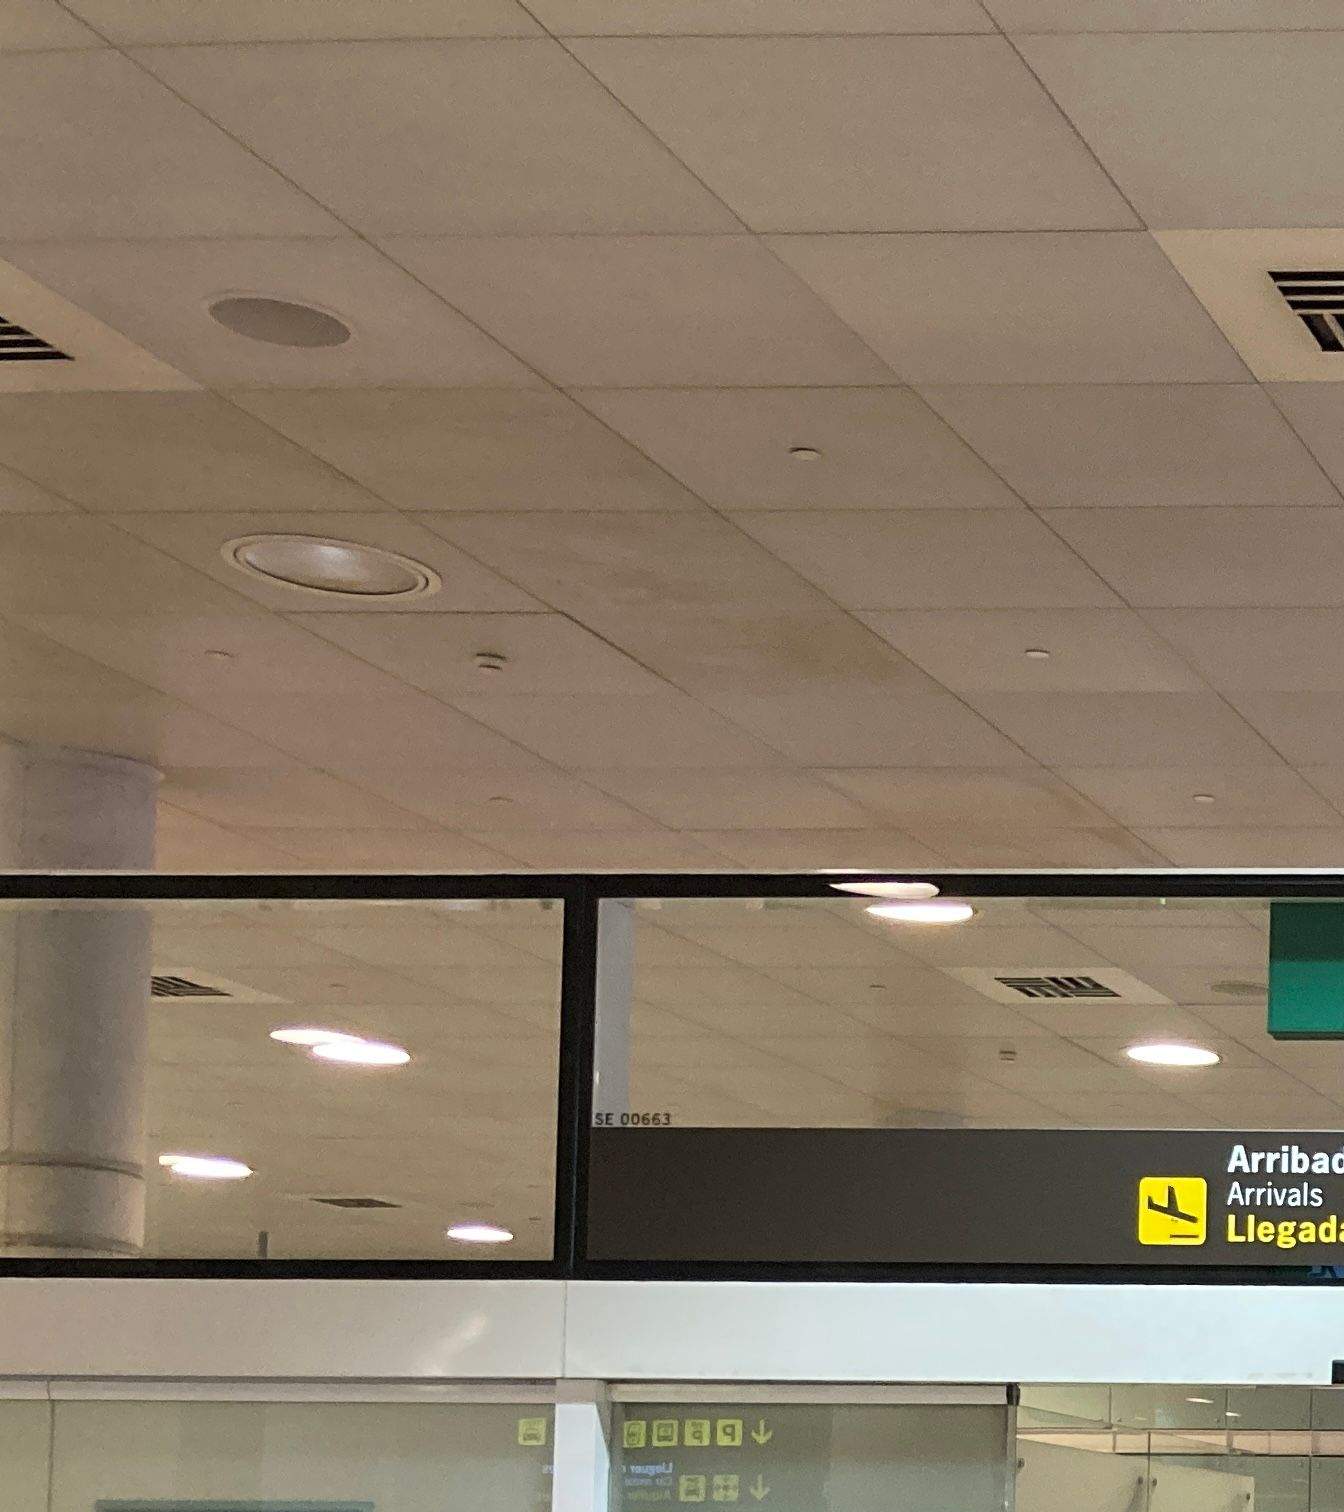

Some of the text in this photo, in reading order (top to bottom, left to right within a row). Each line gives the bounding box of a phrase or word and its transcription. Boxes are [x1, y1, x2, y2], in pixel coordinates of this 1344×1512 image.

[595, 1112, 672, 1126] SE 00663
[1227, 1181, 1323, 1207] Arrivals
